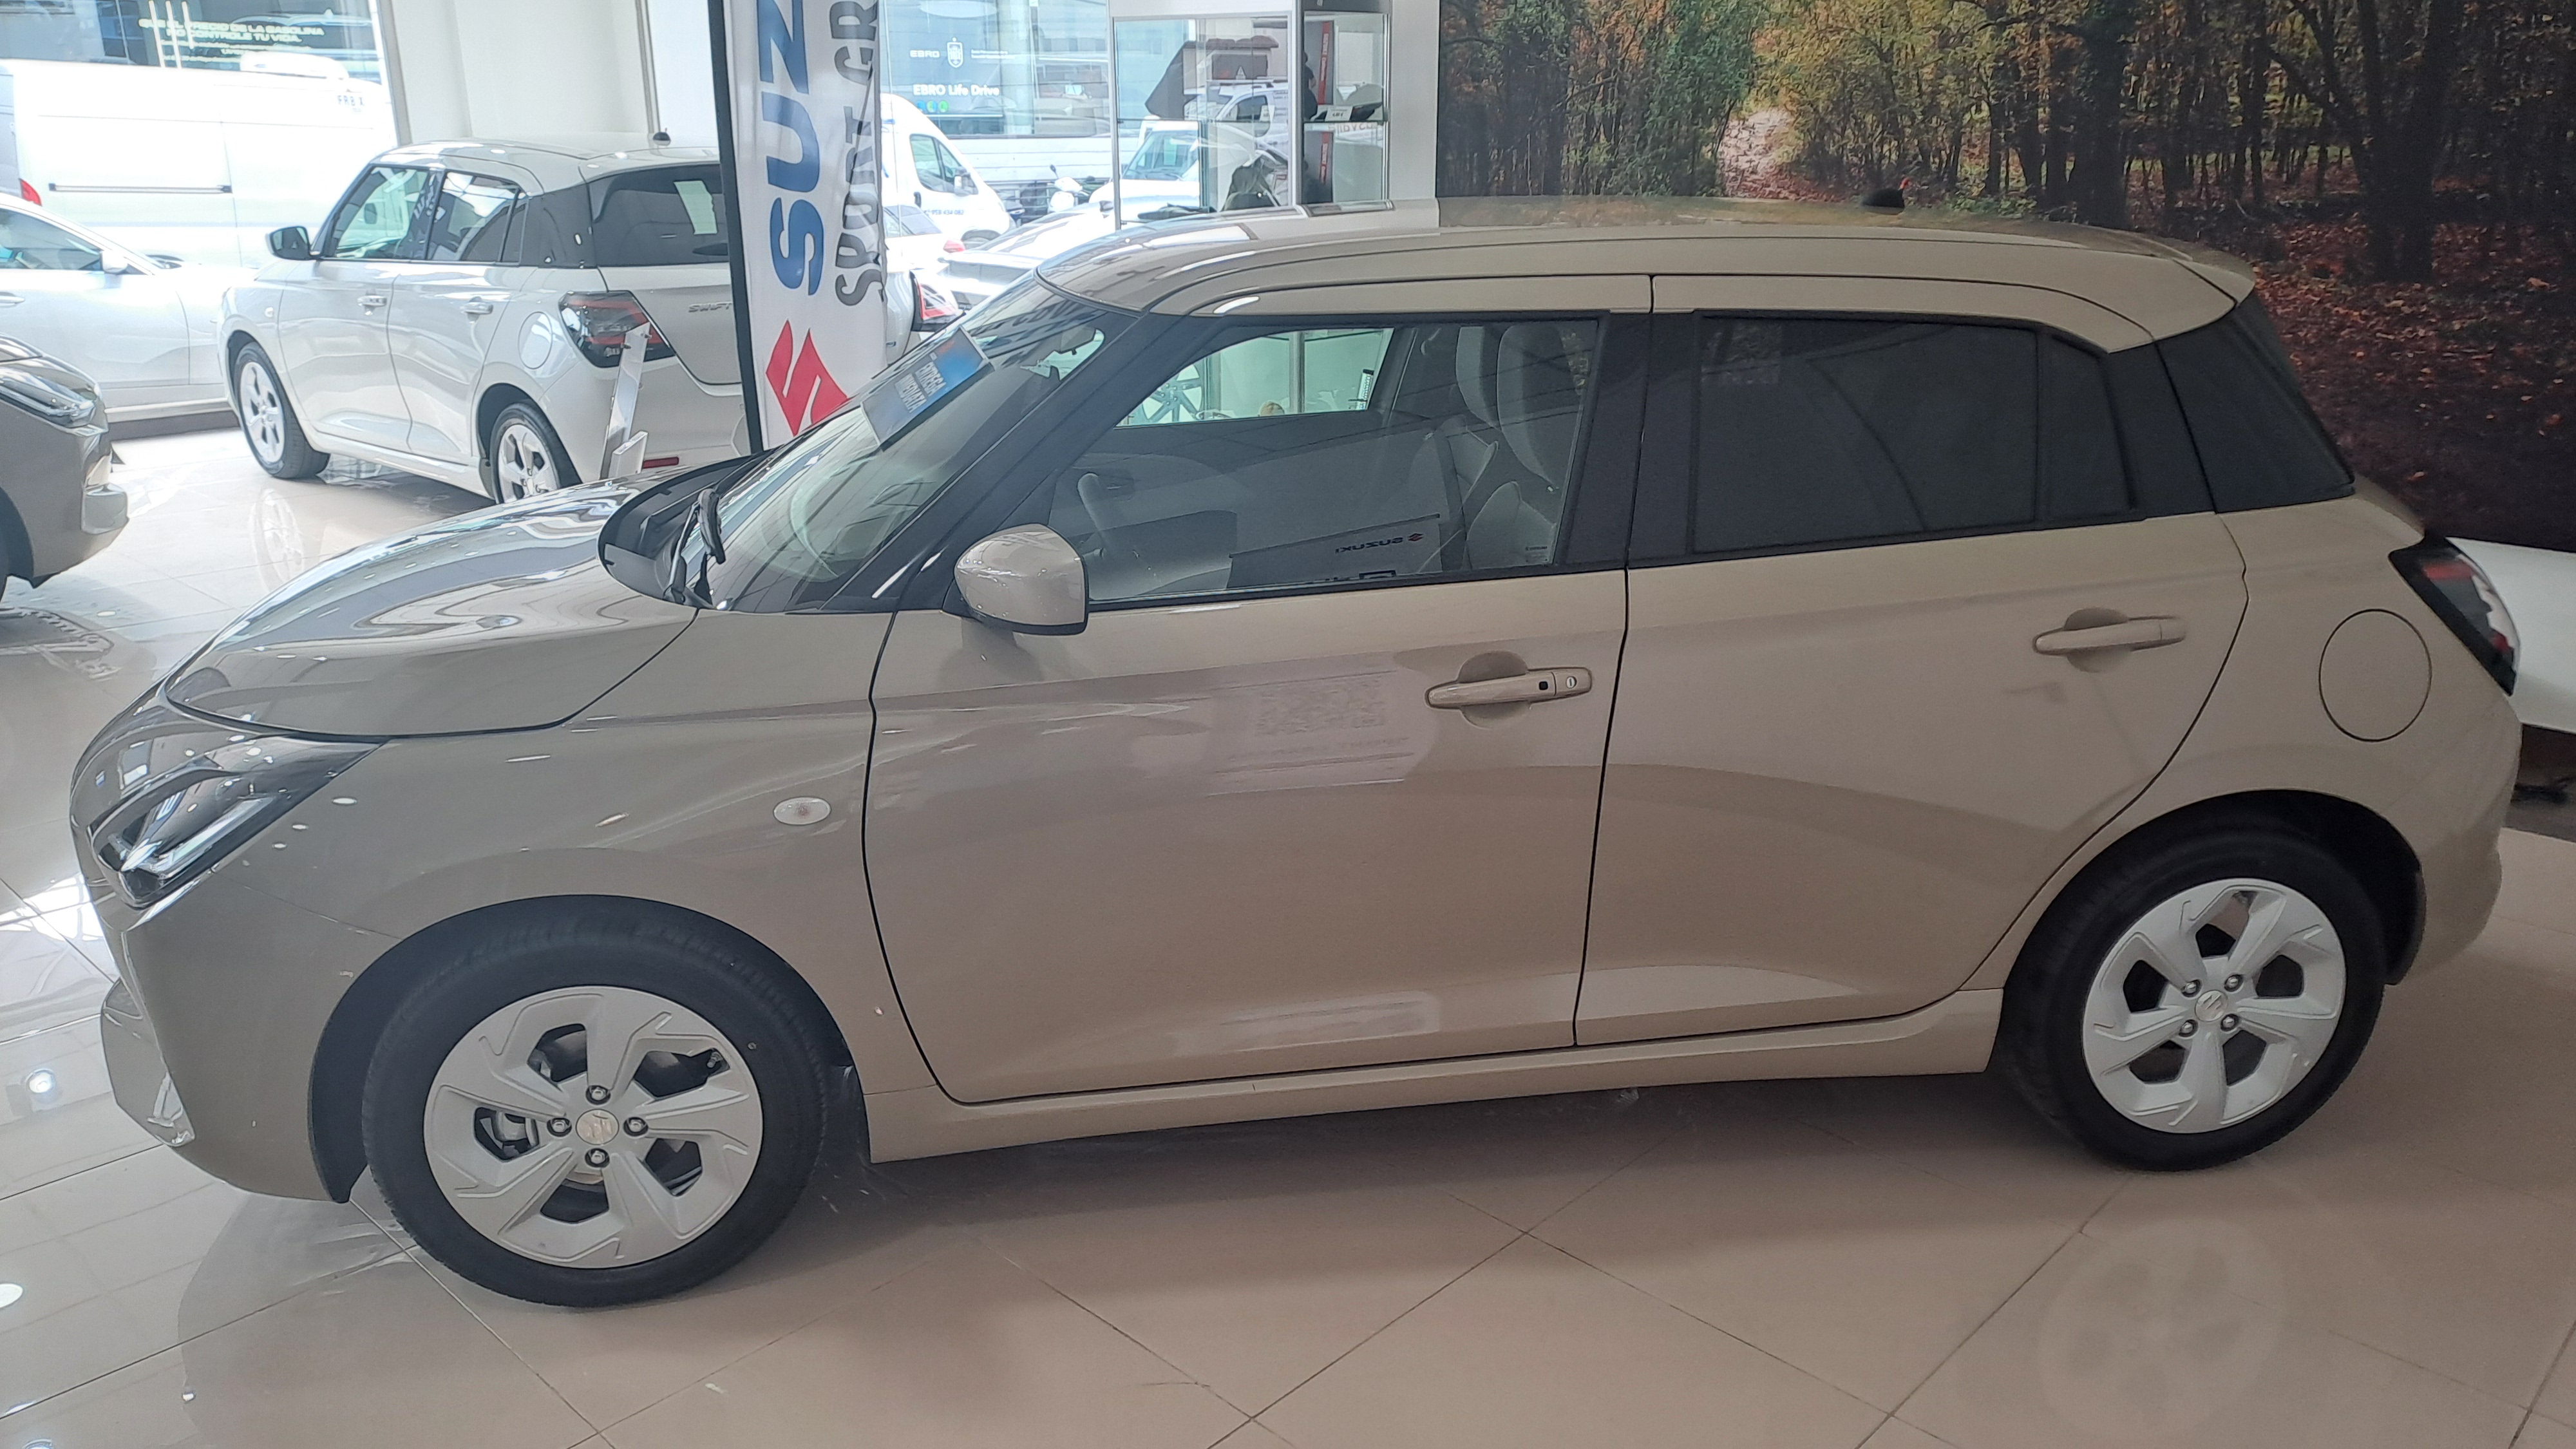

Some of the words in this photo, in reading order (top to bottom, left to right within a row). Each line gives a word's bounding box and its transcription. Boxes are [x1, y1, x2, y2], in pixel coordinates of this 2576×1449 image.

[185, 21, 229, 32] RECIO
[248, 24, 265, 33] LA
[265, 25, 325, 35] GASOLINA
[252, 33, 270, 41] TU
[910, 50, 940, 58] EBRO
[913, 84, 945, 96] EBRO
[948, 84, 969, 96] Life
[971, 84, 999, 96] Drive
[914, 361, 947, 397] ENTREGA
